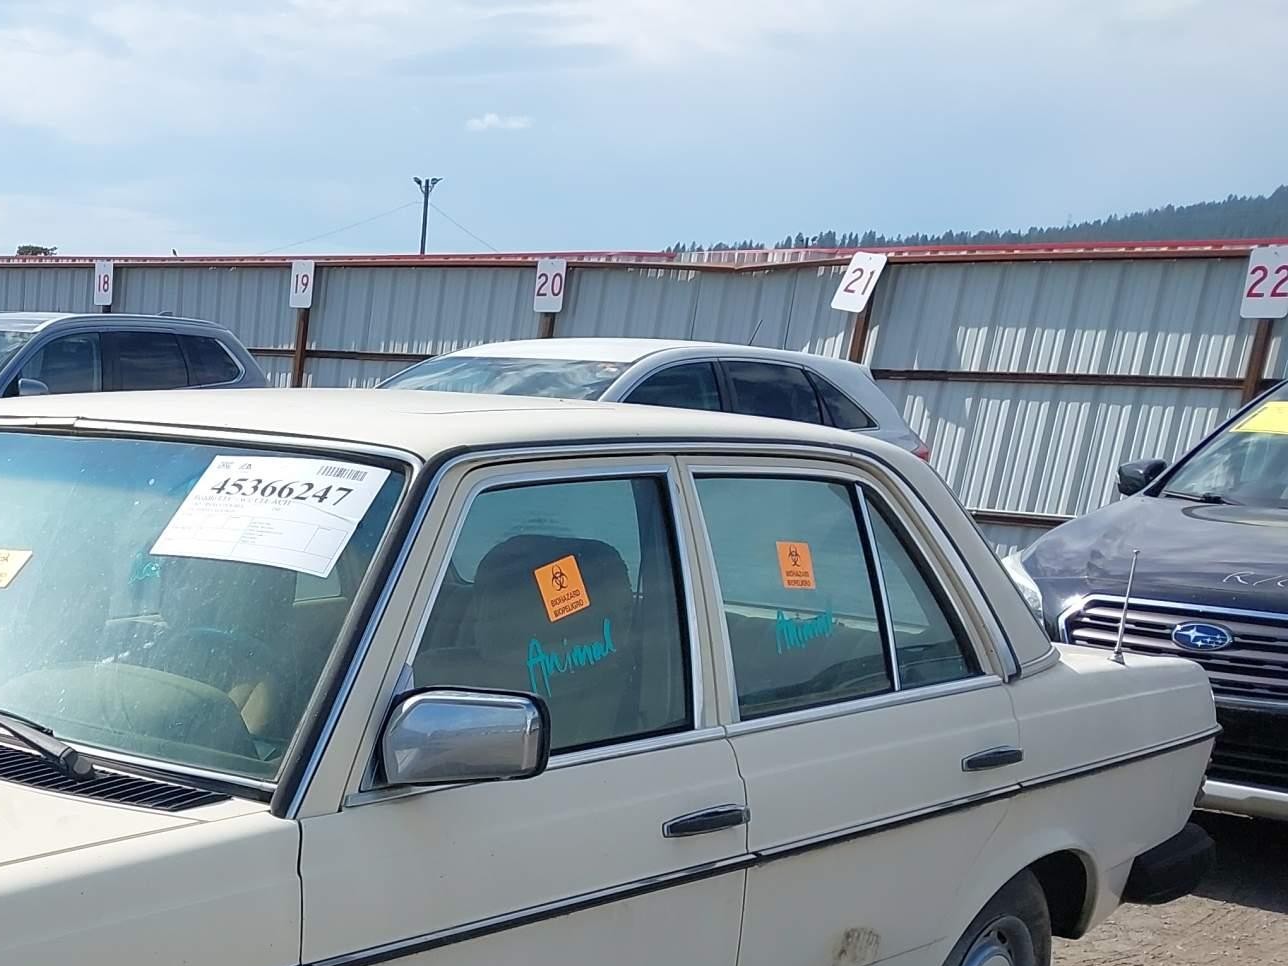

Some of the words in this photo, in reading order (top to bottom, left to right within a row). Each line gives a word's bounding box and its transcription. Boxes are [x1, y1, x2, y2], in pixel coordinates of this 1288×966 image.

[98, 274, 110, 293] 18
[294, 273, 310, 294] 19
[535, 272, 563, 297] 20
[843, 267, 875, 296] 21
[1246, 264, 1288, 298] 22
[211, 477, 354, 506] 45366247
[550, 588, 581, 608] BIOHAZARD
[527, 617, 616, 697] Animal
